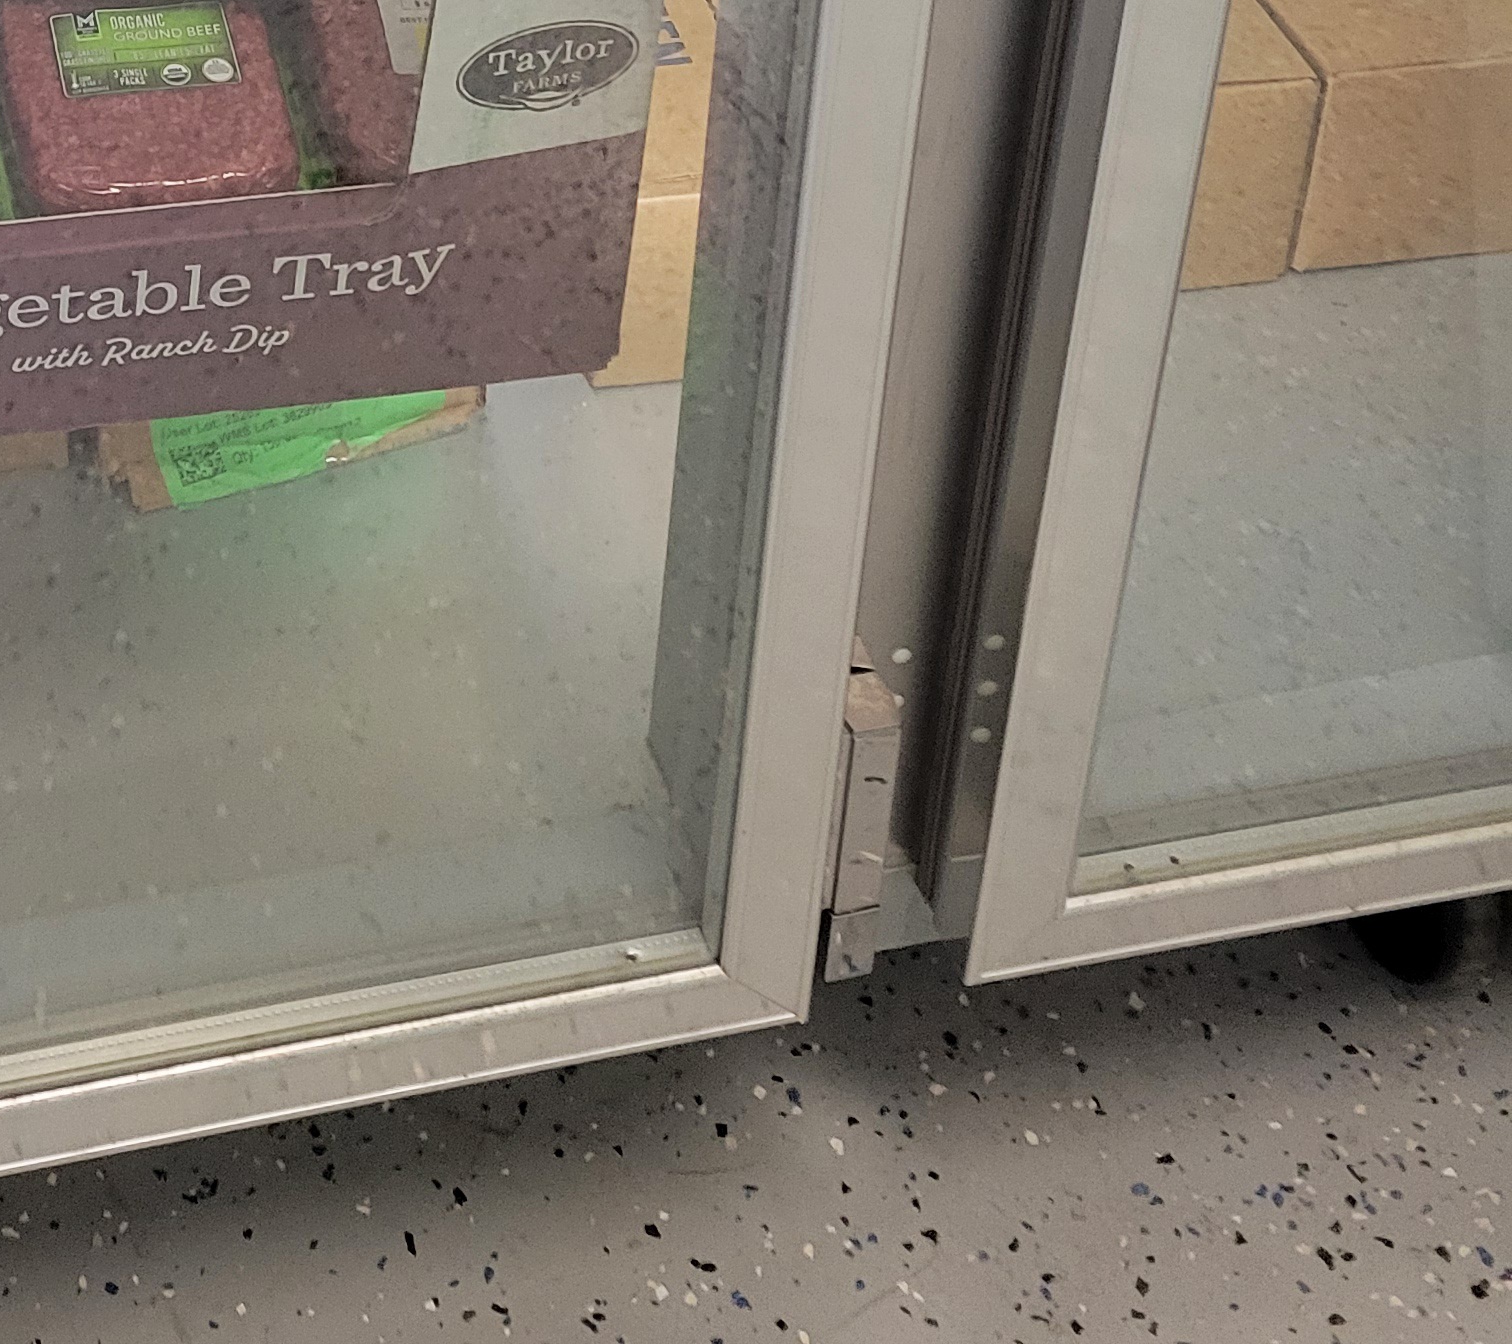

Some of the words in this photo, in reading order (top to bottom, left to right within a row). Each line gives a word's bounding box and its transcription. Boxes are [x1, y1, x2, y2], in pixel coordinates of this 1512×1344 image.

[109, 12, 166, 31] ORGANIC
[113, 26, 183, 42] GROUND
[186, 23, 222, 38] BEEF
[488, 39, 615, 76] Taylor
[512, 70, 583, 94] FARMS
[272, 242, 457, 302] Tray
[11, 342, 95, 374] with
[101, 329, 219, 368] Ranch
[222, 324, 291, 355] Dip
